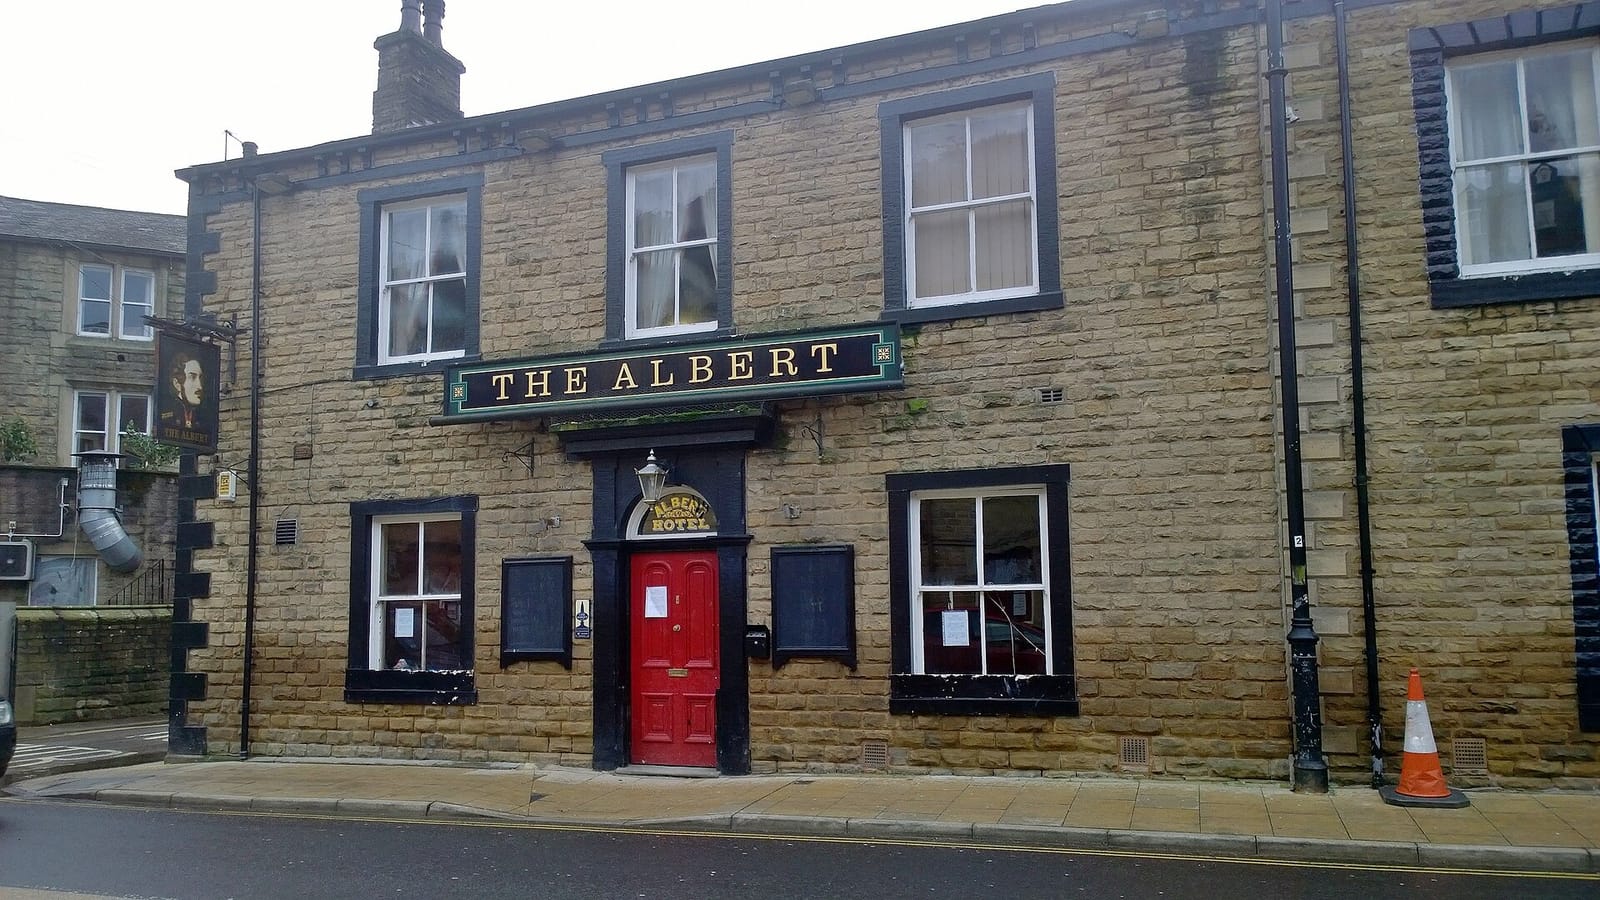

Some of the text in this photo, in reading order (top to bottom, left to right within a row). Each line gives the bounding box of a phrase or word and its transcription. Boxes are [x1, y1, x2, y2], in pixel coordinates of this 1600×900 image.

[492, 343, 838, 400] THE ALBERT
[652, 518, 710, 531] HOTEL
[1295, 537, 1302, 545] 2
